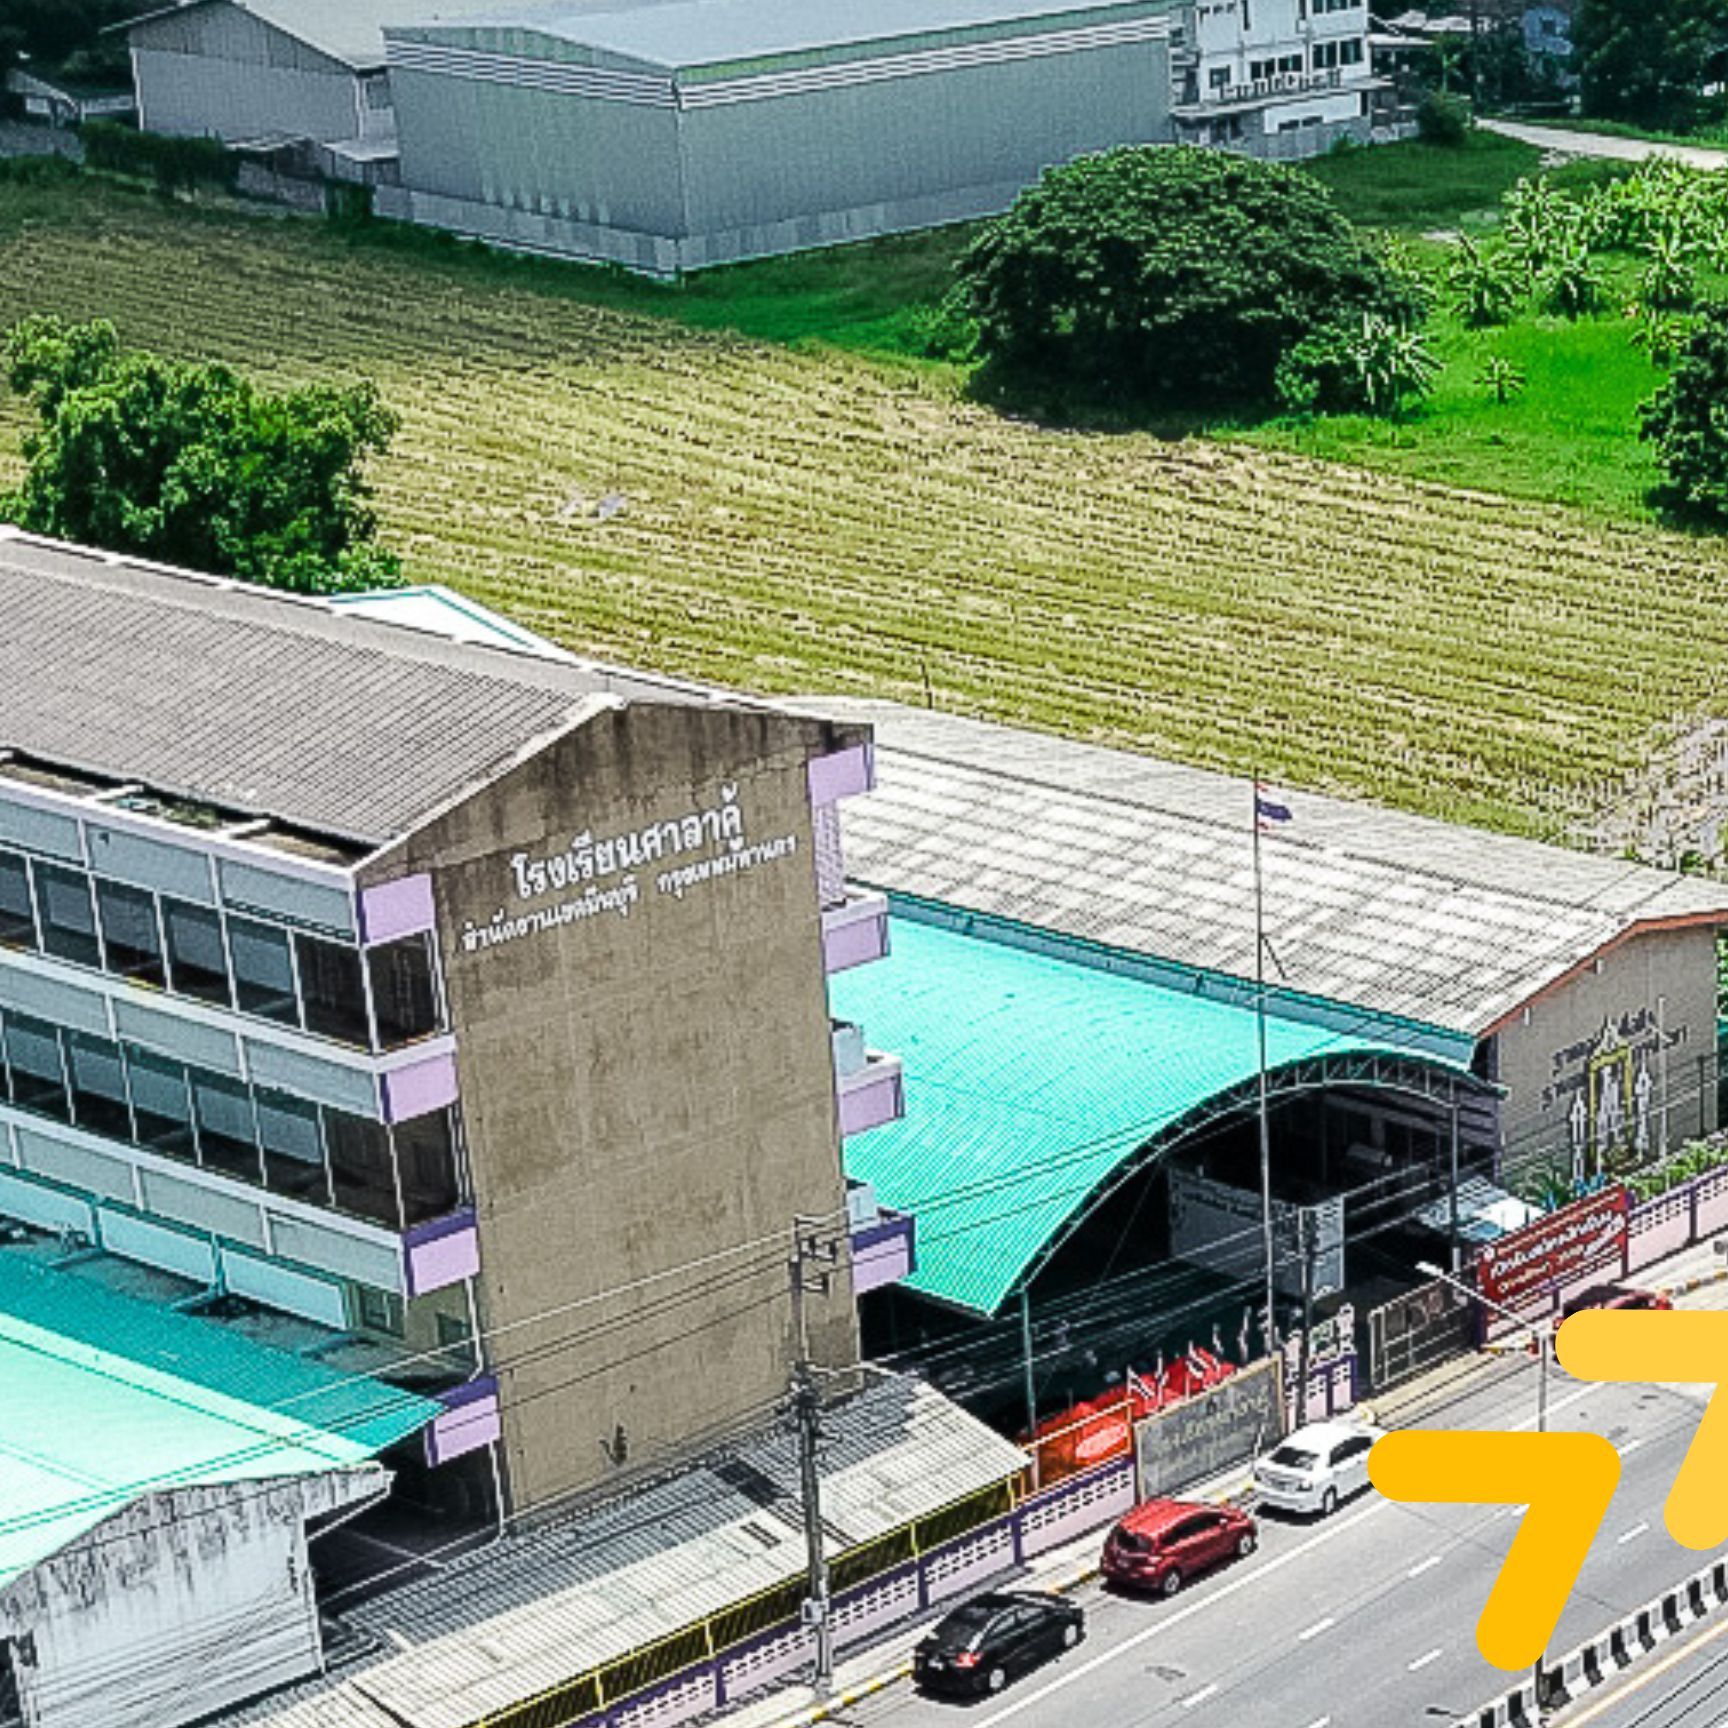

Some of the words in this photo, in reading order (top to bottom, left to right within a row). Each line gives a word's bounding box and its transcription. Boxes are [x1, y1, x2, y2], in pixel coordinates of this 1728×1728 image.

[511, 783, 744, 899] โรงเรียนศาลาคู้
